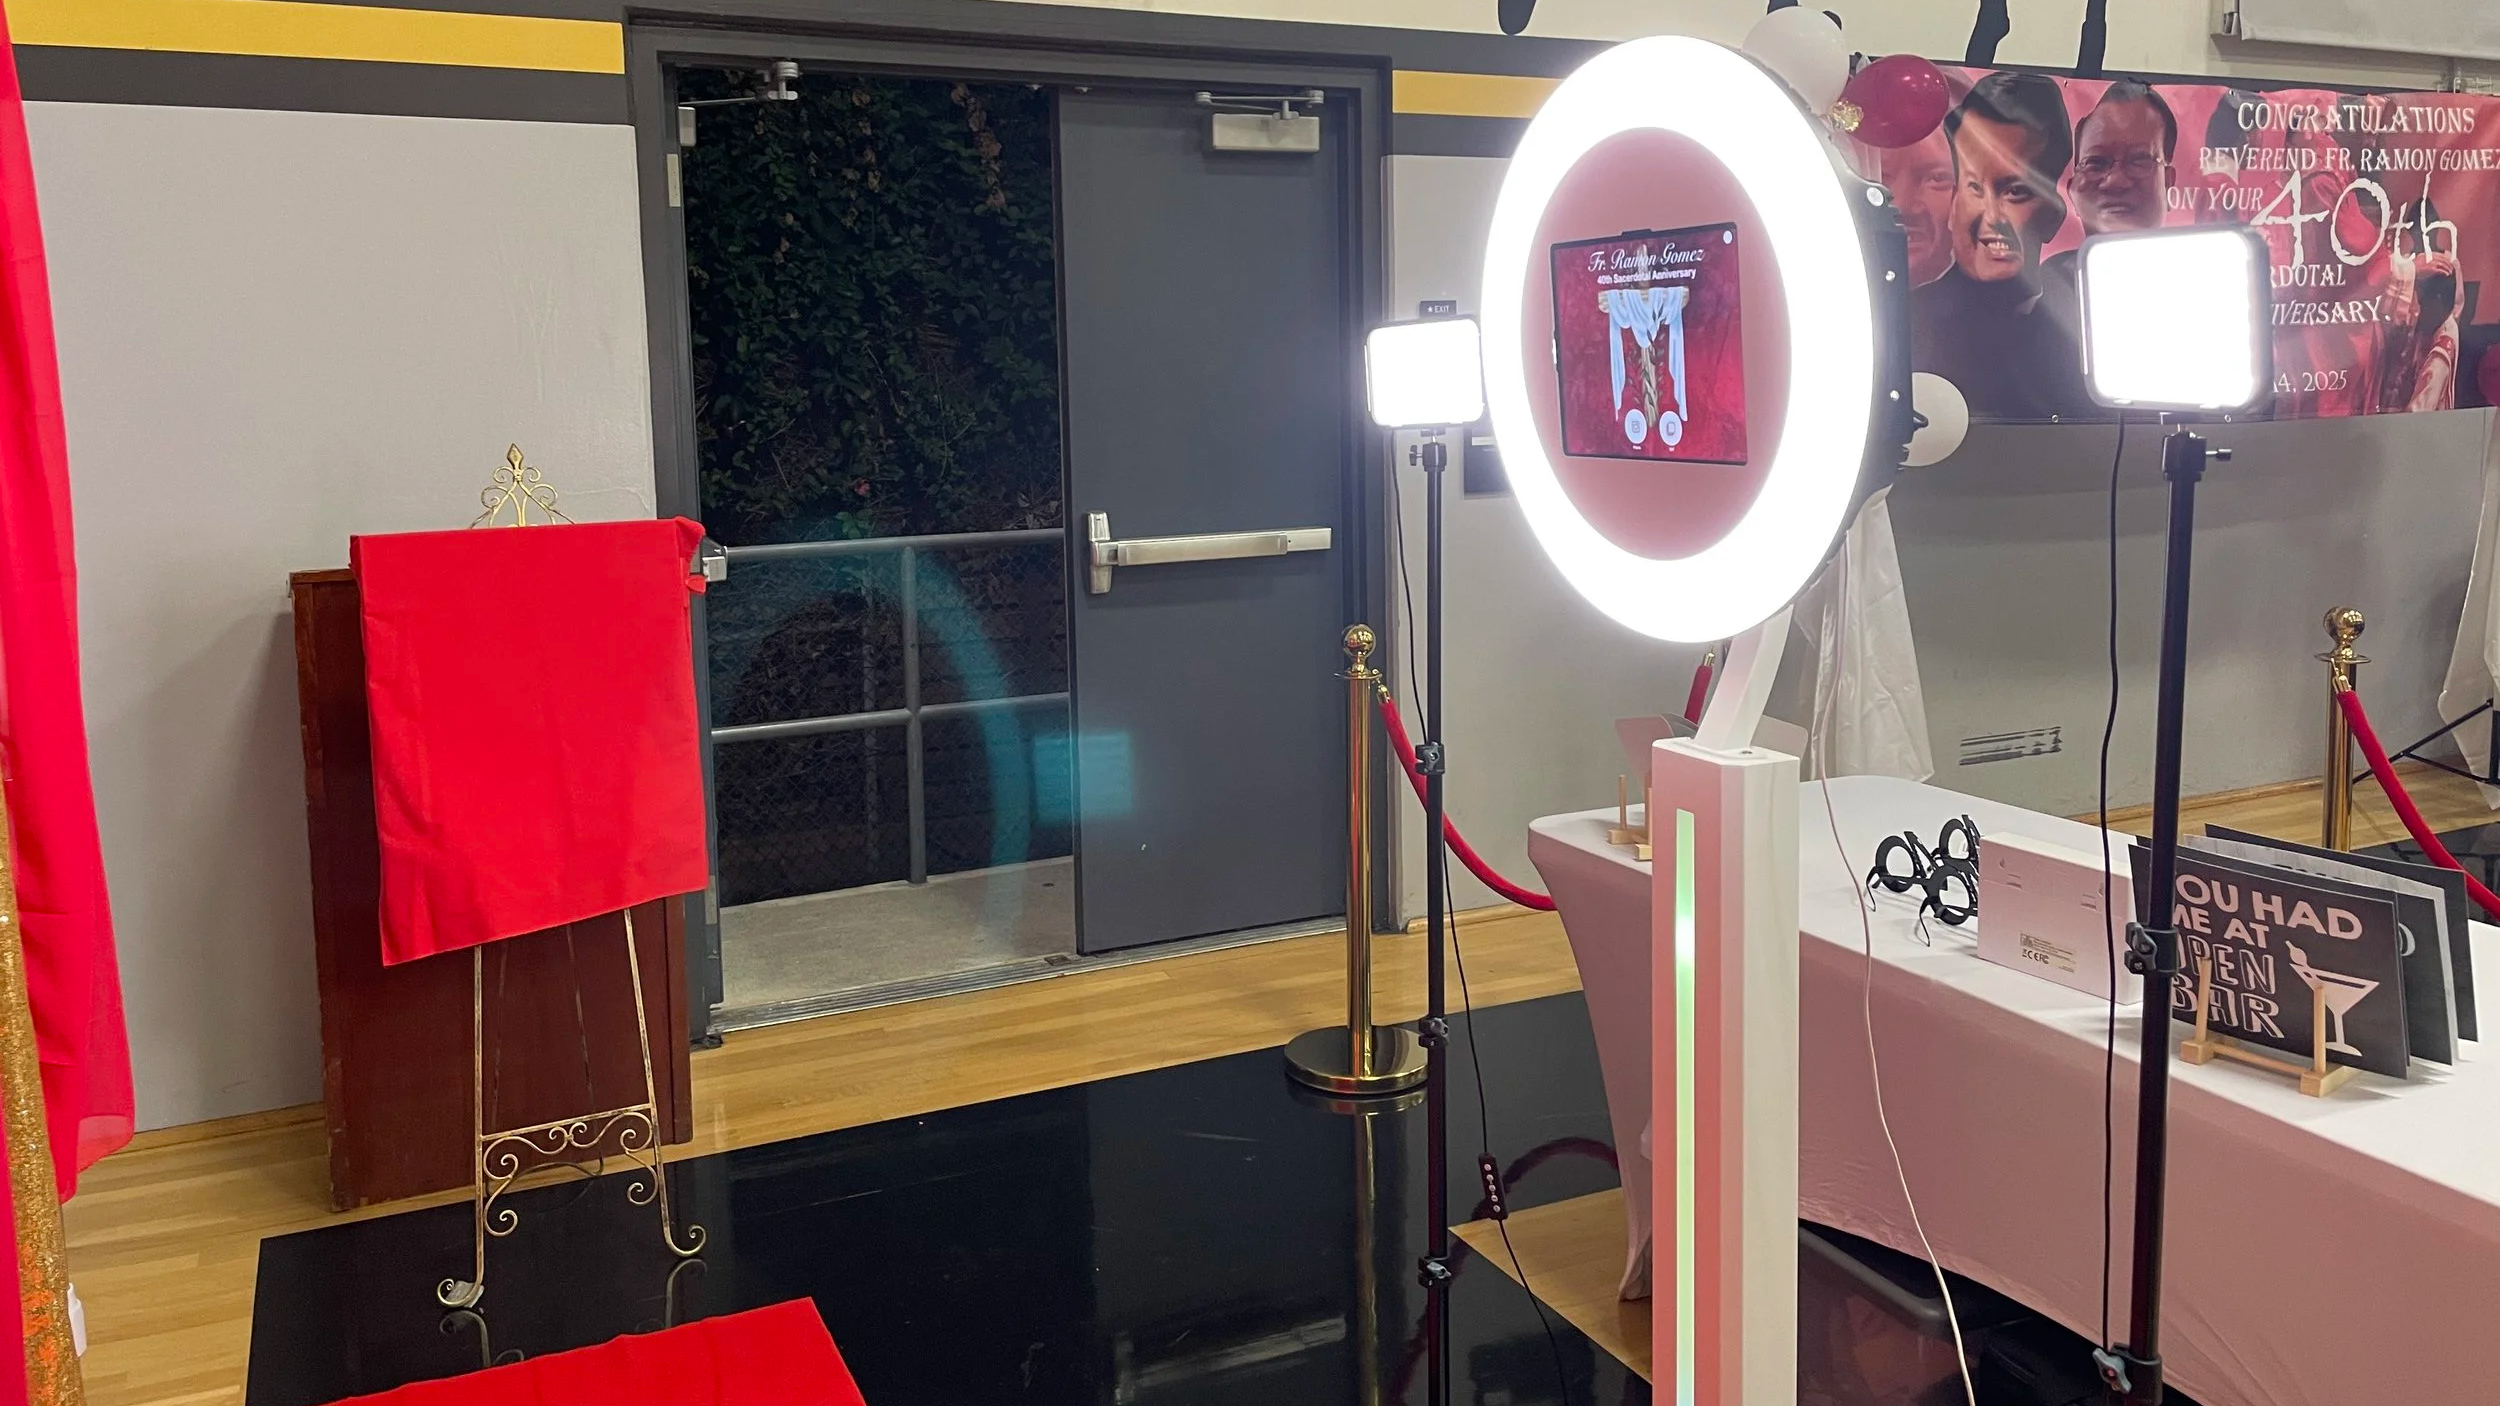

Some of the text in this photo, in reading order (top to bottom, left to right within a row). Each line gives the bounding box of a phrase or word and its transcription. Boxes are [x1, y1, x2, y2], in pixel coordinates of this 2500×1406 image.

[2237, 102, 2475, 134] CONGRATULATIONS
[2199, 144, 2316, 171] REVEREND
[2325, 147, 2355, 171] FR.
[2360, 148, 2437, 171] RAMON
[2166, 170, 2458, 269] ON YOUR 40th
[1588, 242, 1705, 272] Fr. Ramon Gomez
[1597, 268, 1697, 285] 40th Sacerdotal Anniversary
[1434, 305, 1450, 314] EXIT
[2271, 295, 2391, 325] IVERSARY.
[2302, 370, 2347, 392] 2025
[2174, 873, 2239, 914] OU
[2251, 890, 2363, 940] HAD
[2223, 918, 2270, 949] AT
